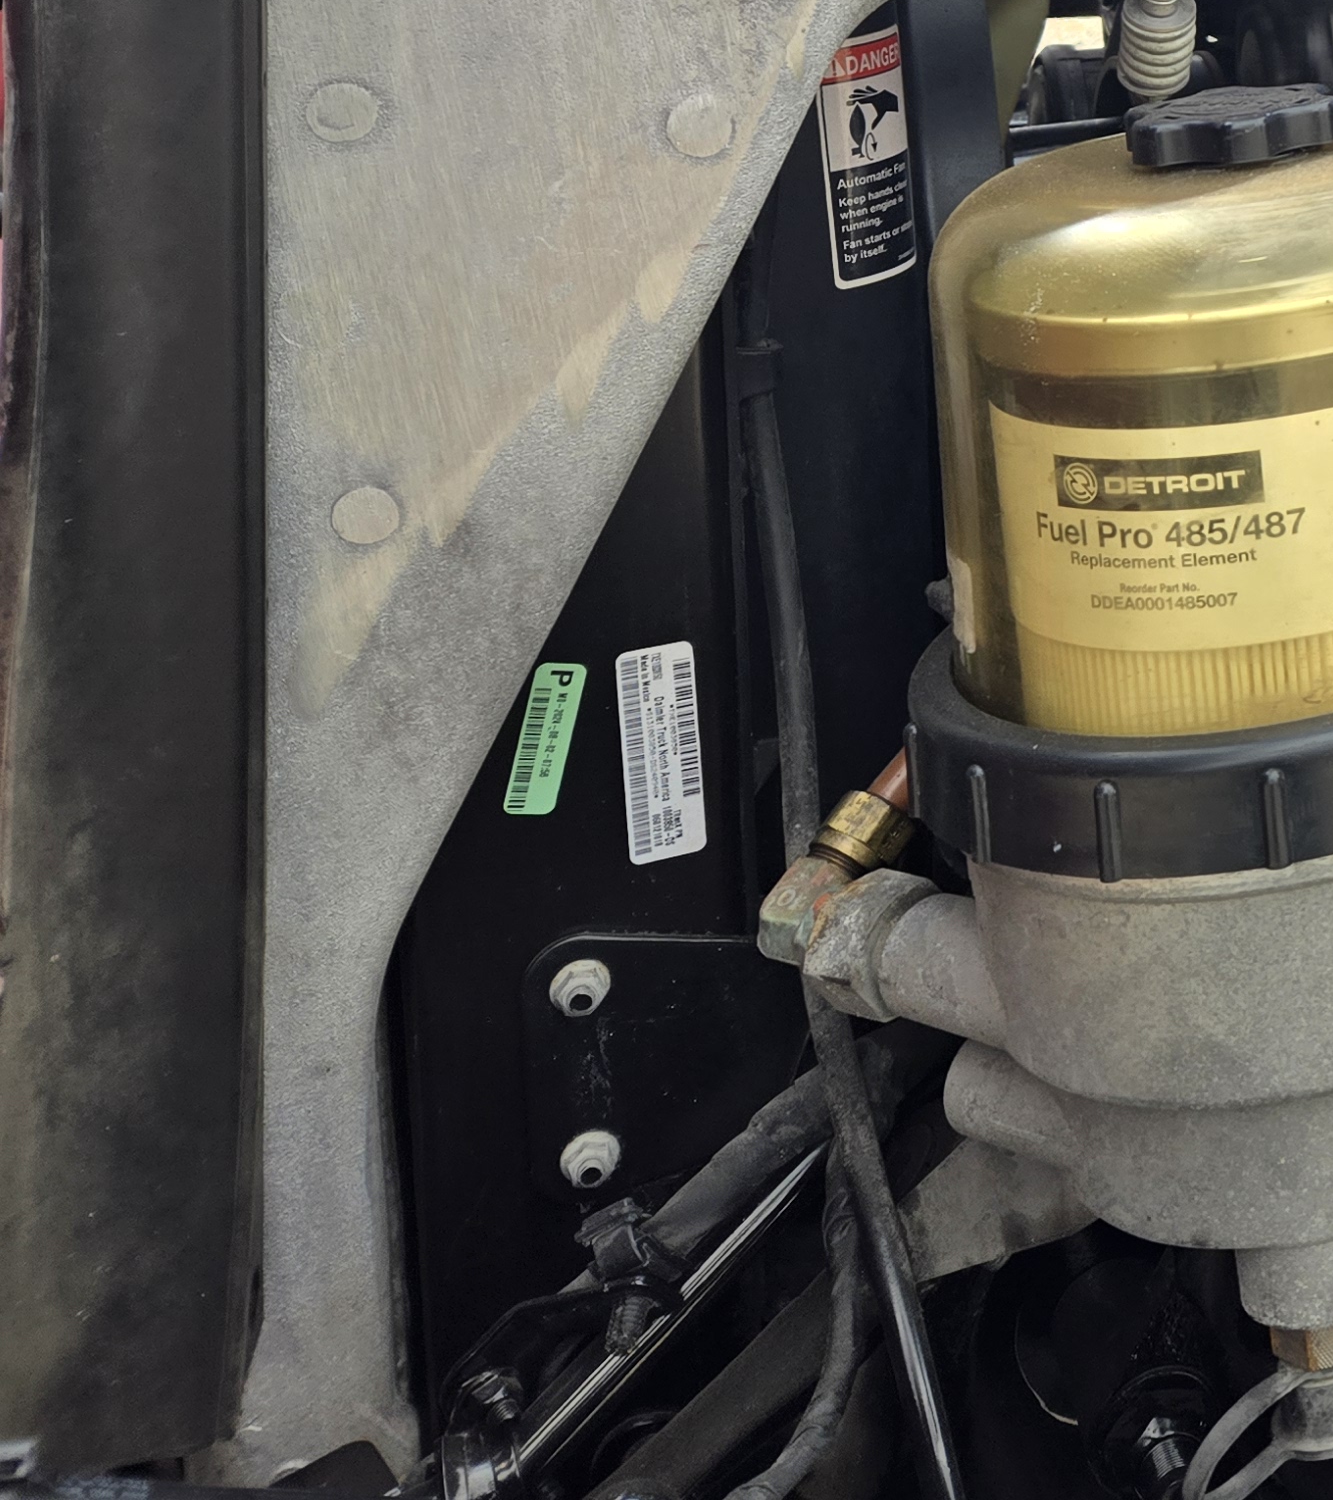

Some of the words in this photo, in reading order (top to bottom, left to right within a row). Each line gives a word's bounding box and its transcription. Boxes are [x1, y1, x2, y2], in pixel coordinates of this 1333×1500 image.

[845, 42, 900, 73] DANGER
[837, 167, 893, 191] Automatic
[838, 195, 866, 208] Keep
[868, 185, 891, 200] hands
[840, 206, 869, 220] when
[870, 197, 896, 216] engine
[843, 239, 863, 250] Fan
[864, 229, 891, 244] starts
[892, 226, 901, 236] or
[845, 250, 859, 264] by
[1103, 469, 1245, 495] DETROIT
[1036, 511, 1087, 546] Fuel
[1165, 507, 1306, 547] 485/487
[1070, 551, 1175, 569] Replacement
[1181, 548, 1257, 568] Element
[1119, 582, 1157, 593] Reorder
[1160, 583, 1180, 593] Part
[1182, 582, 1200, 592] No.
[550, 670, 574, 687] P
[654, 697, 665, 725] Daimler
[656, 727, 667, 748] Truck
[658, 749, 669, 771] North
[660, 772, 671, 802] America
